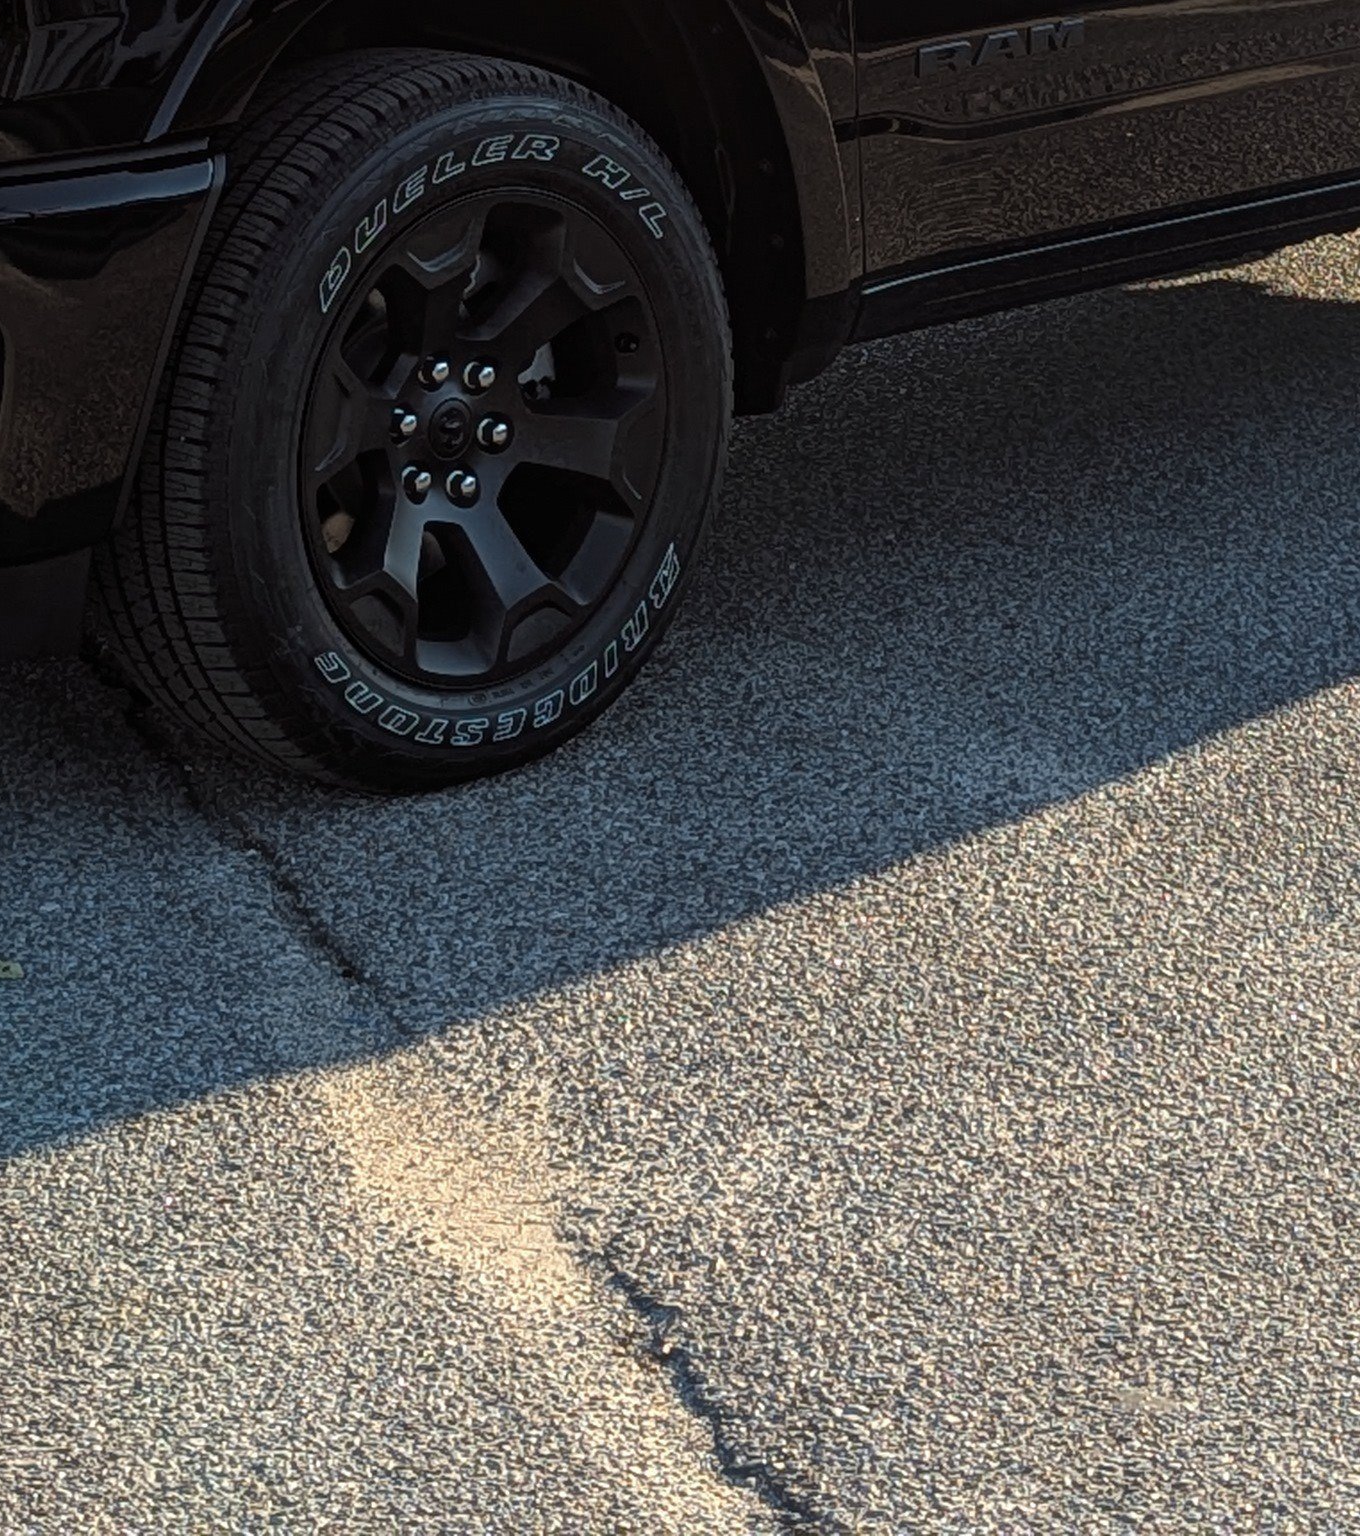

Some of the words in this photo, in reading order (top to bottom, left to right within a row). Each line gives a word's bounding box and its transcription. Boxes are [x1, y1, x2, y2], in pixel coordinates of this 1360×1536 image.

[913, 16, 1086, 79] RAM
[318, 133, 561, 314] DUELER
[313, 540, 683, 747] BRIDGESTONE
